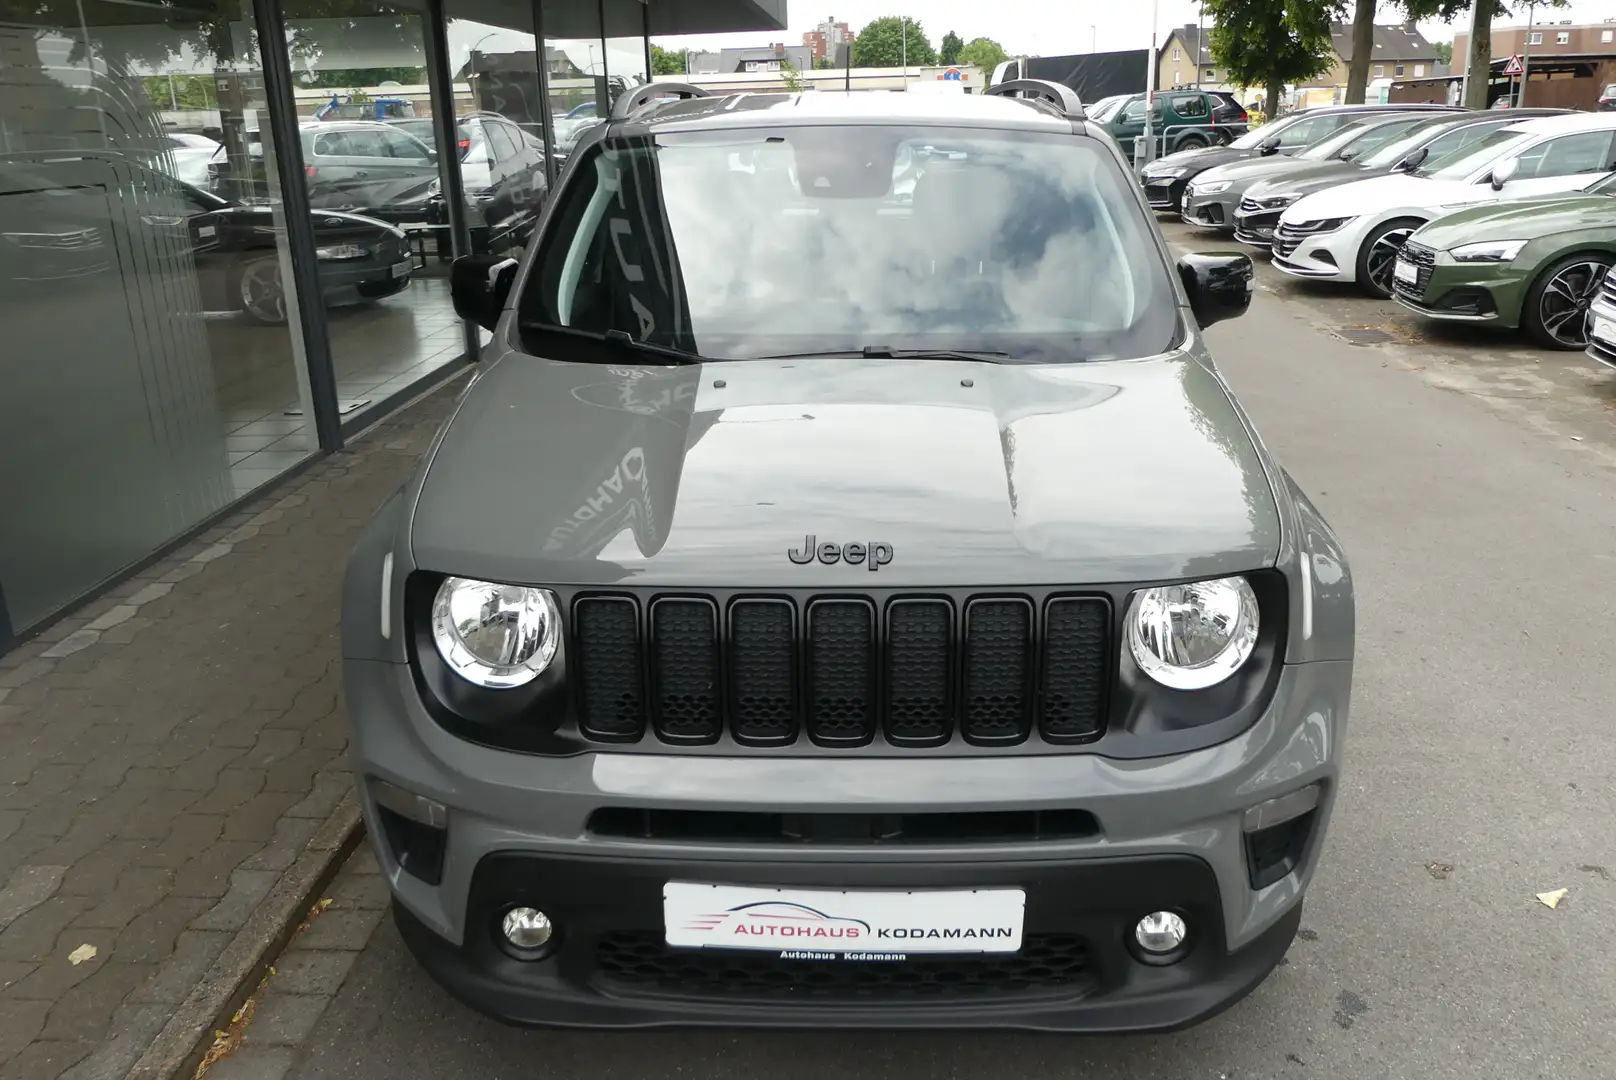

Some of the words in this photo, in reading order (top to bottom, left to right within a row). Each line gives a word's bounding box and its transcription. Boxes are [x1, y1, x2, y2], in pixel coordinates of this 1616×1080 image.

[788, 534, 894, 571] Jeep
[734, 924, 860, 938] AUTOHAUS
[877, 927, 1012, 939] KODAMANN
[780, 950, 836, 960] Autohaus
[844, 952, 906, 961] Kodamann
